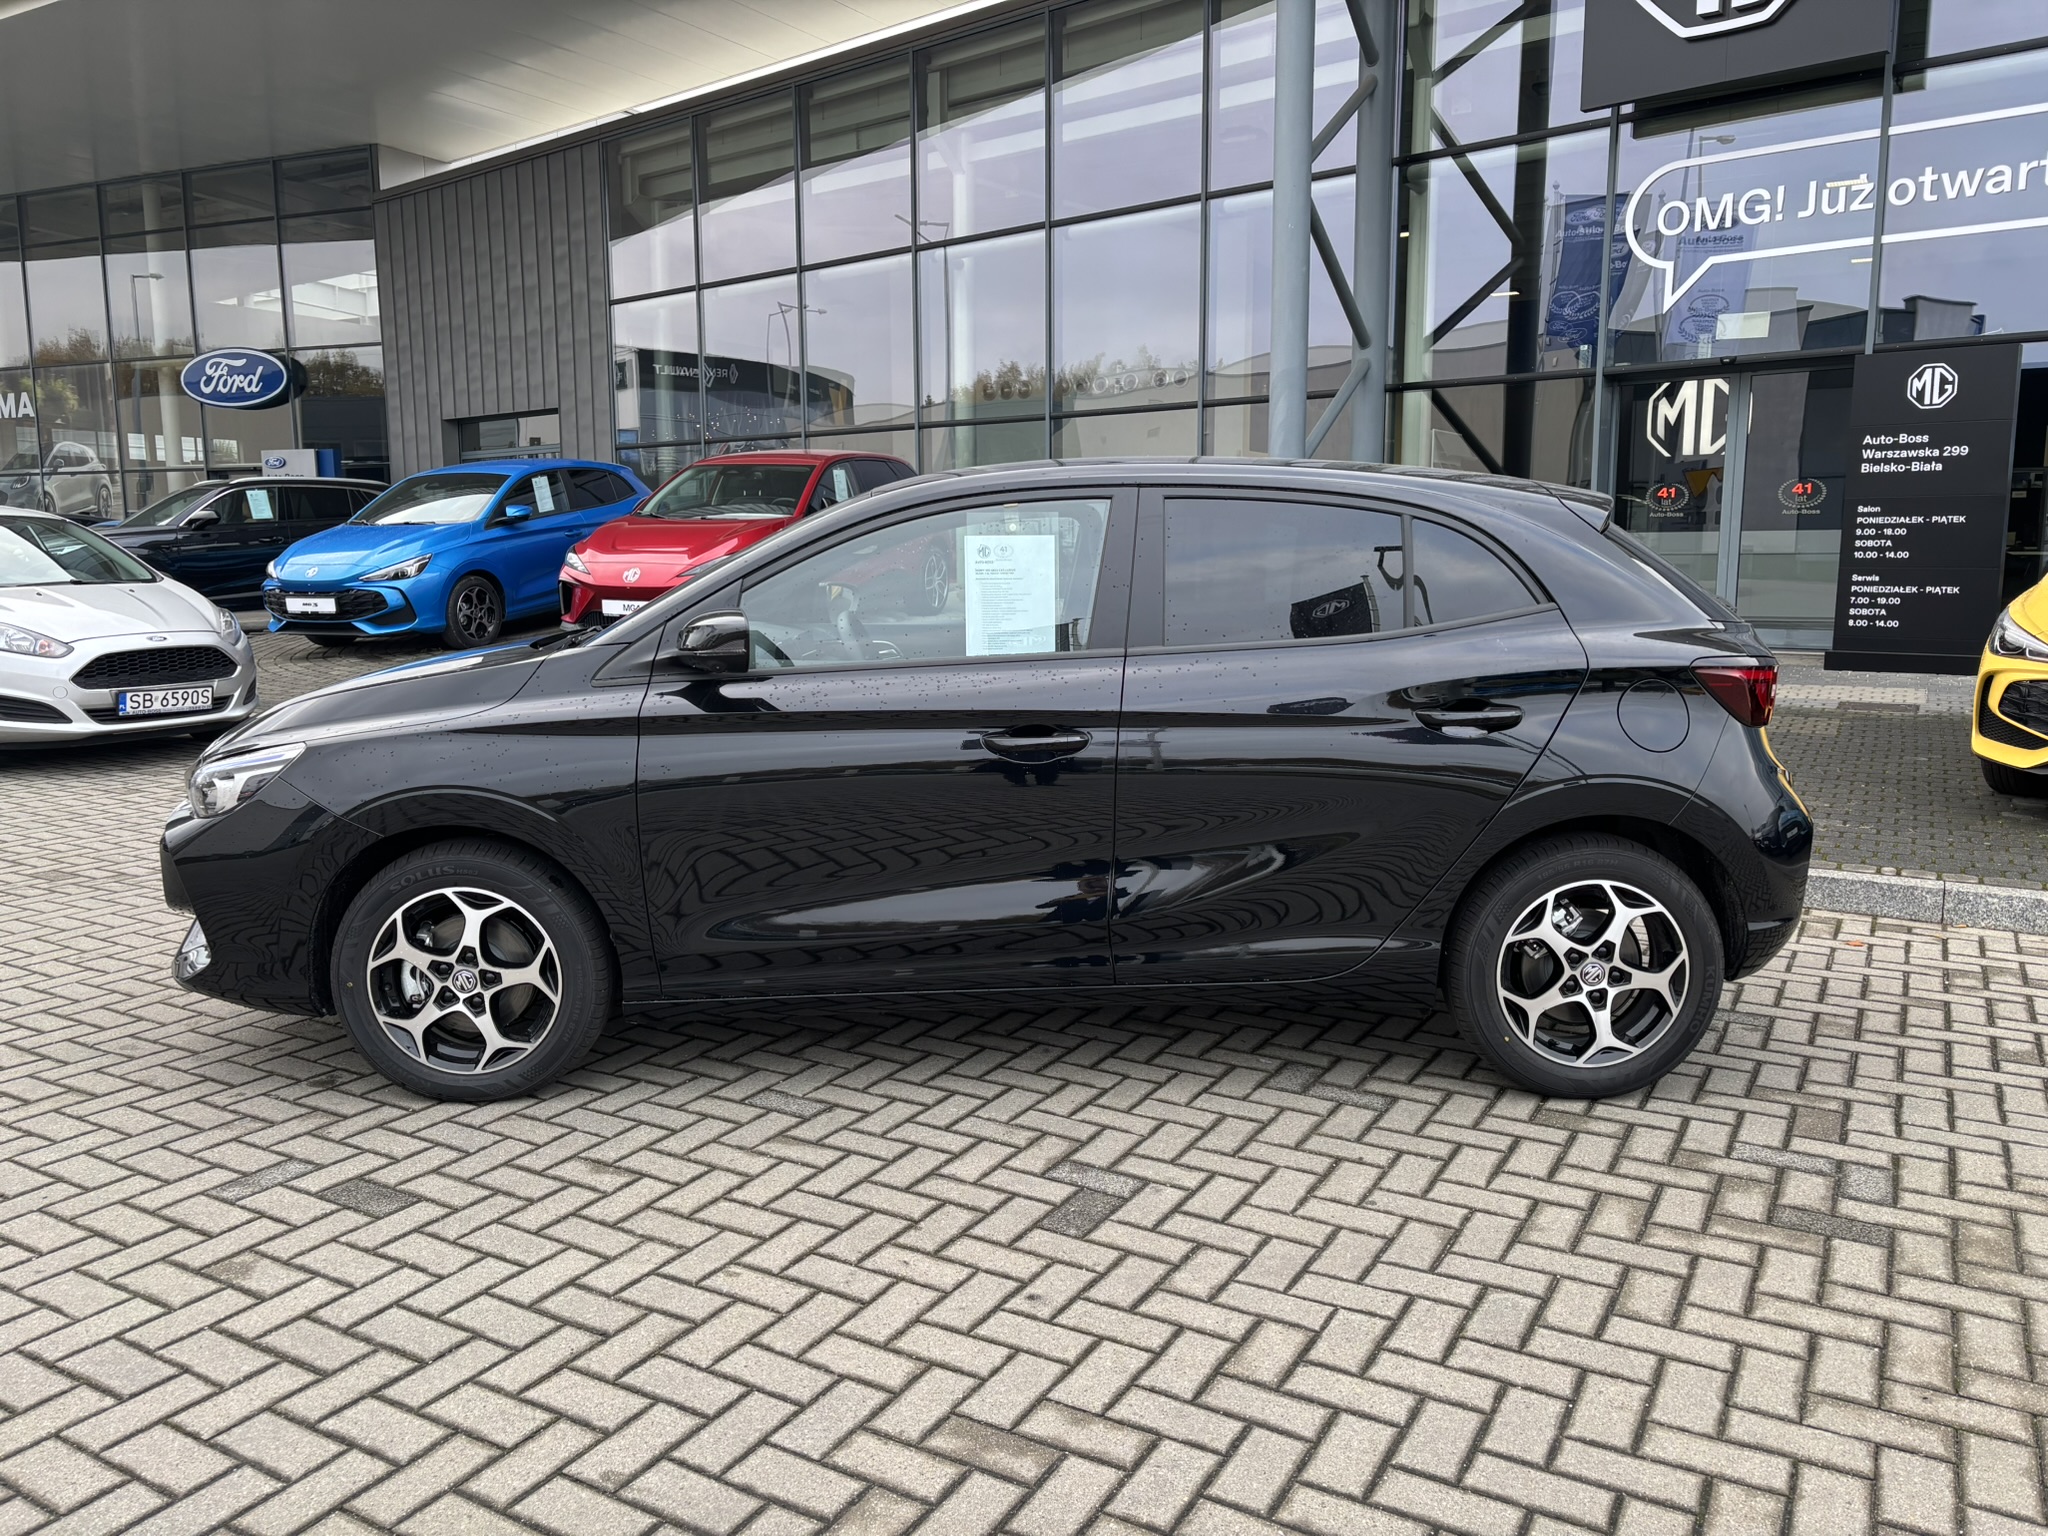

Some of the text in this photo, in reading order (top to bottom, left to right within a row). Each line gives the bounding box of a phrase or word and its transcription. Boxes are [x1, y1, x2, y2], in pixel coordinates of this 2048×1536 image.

[1657, 185, 1786, 236] OMG!
[1798, 173, 1875, 218] Już
[200, 357, 263, 394] Ford
[1910, 366, 1955, 406] MG
[1862, 434, 1929, 445] Auto-Boss
[1862, 445, 1969, 459] Warszawska 299
[1861, 461, 1943, 473] Bielsko-Biała
[1657, 487, 1676, 498] 41
[1792, 482, 1813, 494] 41
[1857, 505, 1881, 513] Salon
[1856, 516, 1925, 524] PONIEDZIAŁEK
[1931, 515, 1967, 525] PIĄTEK
[1883, 527, 1907, 535] 18.00
[1854, 539, 1893, 547] SOBOTA
[1854, 551, 1878, 559] 10.00
[1885, 551, 1910, 559] 14.00
[1851, 574, 1880, 582] Serwis
[1850, 585, 1919, 594] PONIEDZIAŁEK
[1925, 586, 1960, 595] PIĄTEK
[1849, 596, 1870, 604] 7.00
[1876, 597, 1901, 605] 19.00
[1848, 608, 1887, 616] SOBOTA
[1847, 619, 1868, 627] 8.00
[1875, 620, 1899, 628] 14.00
[129, 689, 211, 710] SB 6590S
[388, 865, 456, 894] SOLUS
[1582, 965, 1604, 984] MG
[454, 971, 476, 992] MG
[1687, 964, 1716, 1034] KUMHO
